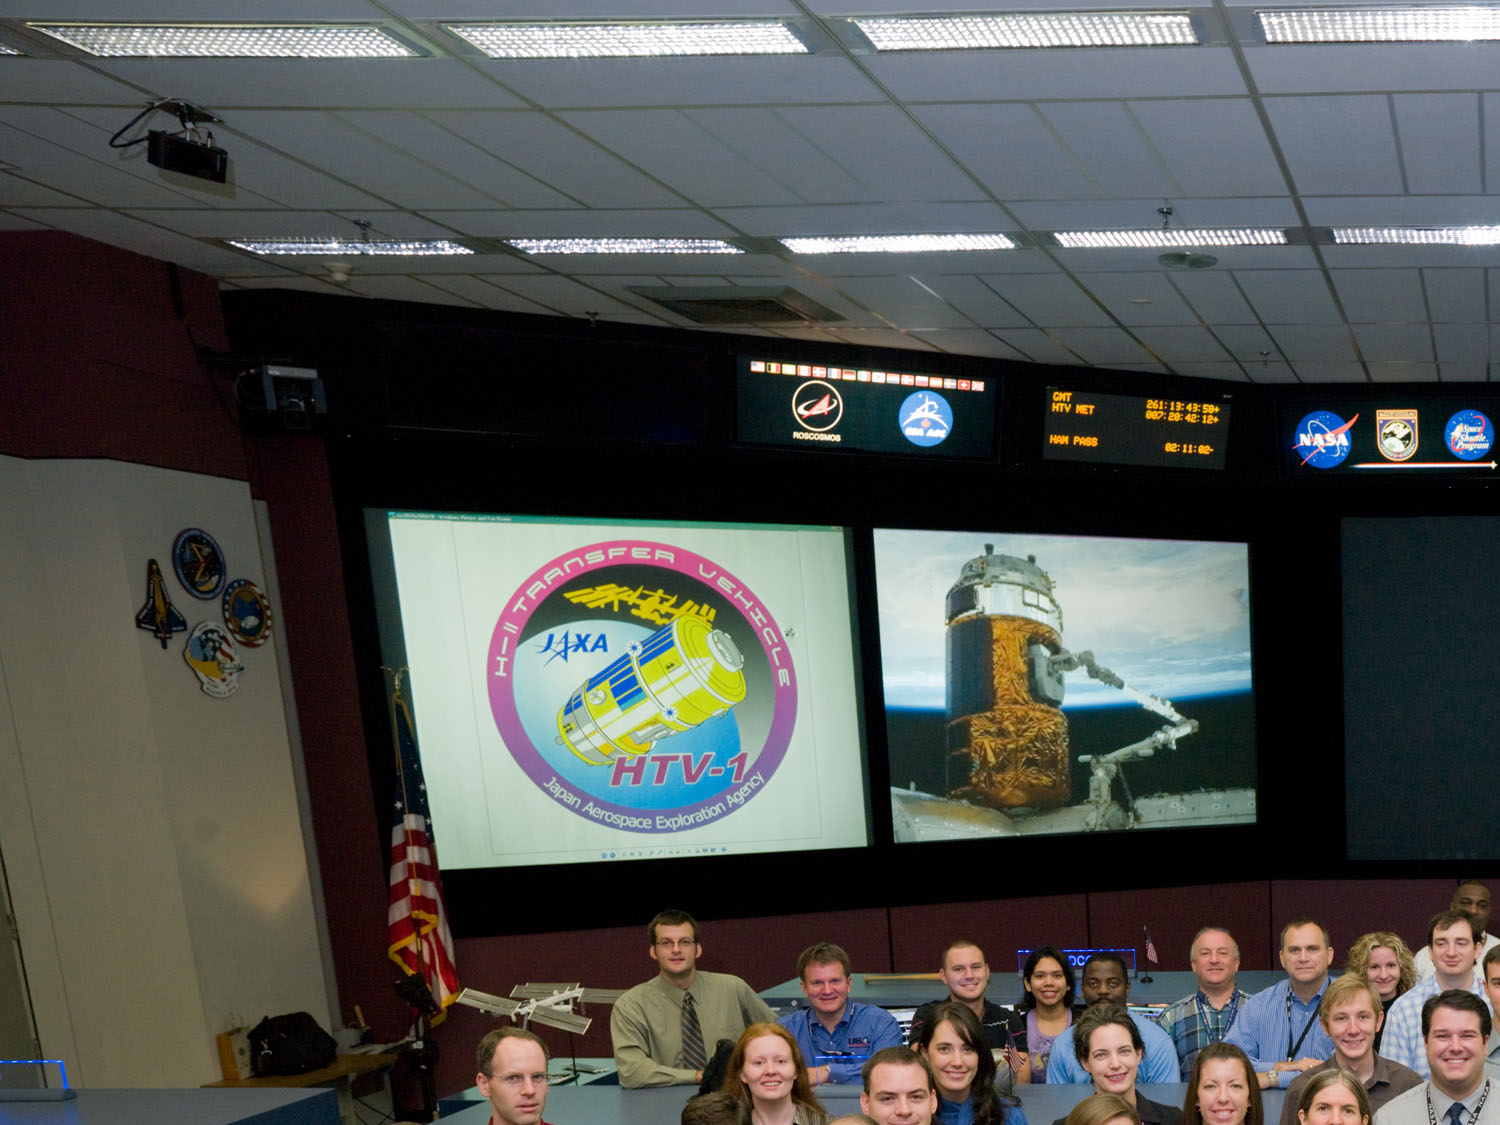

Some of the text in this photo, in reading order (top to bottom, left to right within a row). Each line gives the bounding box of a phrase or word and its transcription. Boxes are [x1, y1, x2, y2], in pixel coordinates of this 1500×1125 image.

[1053, 392, 1072, 402] GMT
[1052, 403, 1071, 413] HTV
[1076, 404, 1095, 415] MET
[1461, 423, 1482, 434] Space
[792, 431, 841, 442] ROSCOSMOS
[1073, 435, 1099, 447] PASS
[1299, 433, 1349, 447] NASA
[1456, 440, 1490, 452] Program
[512, 545, 675, 613] TRANSFER
[697, 562, 791, 688] VEHICLE
[535, 628, 609, 668] JAXA
[609, 750, 750, 788] HTV-1
[542, 771, 768, 831] Japan Aerospace Exploration Agency
